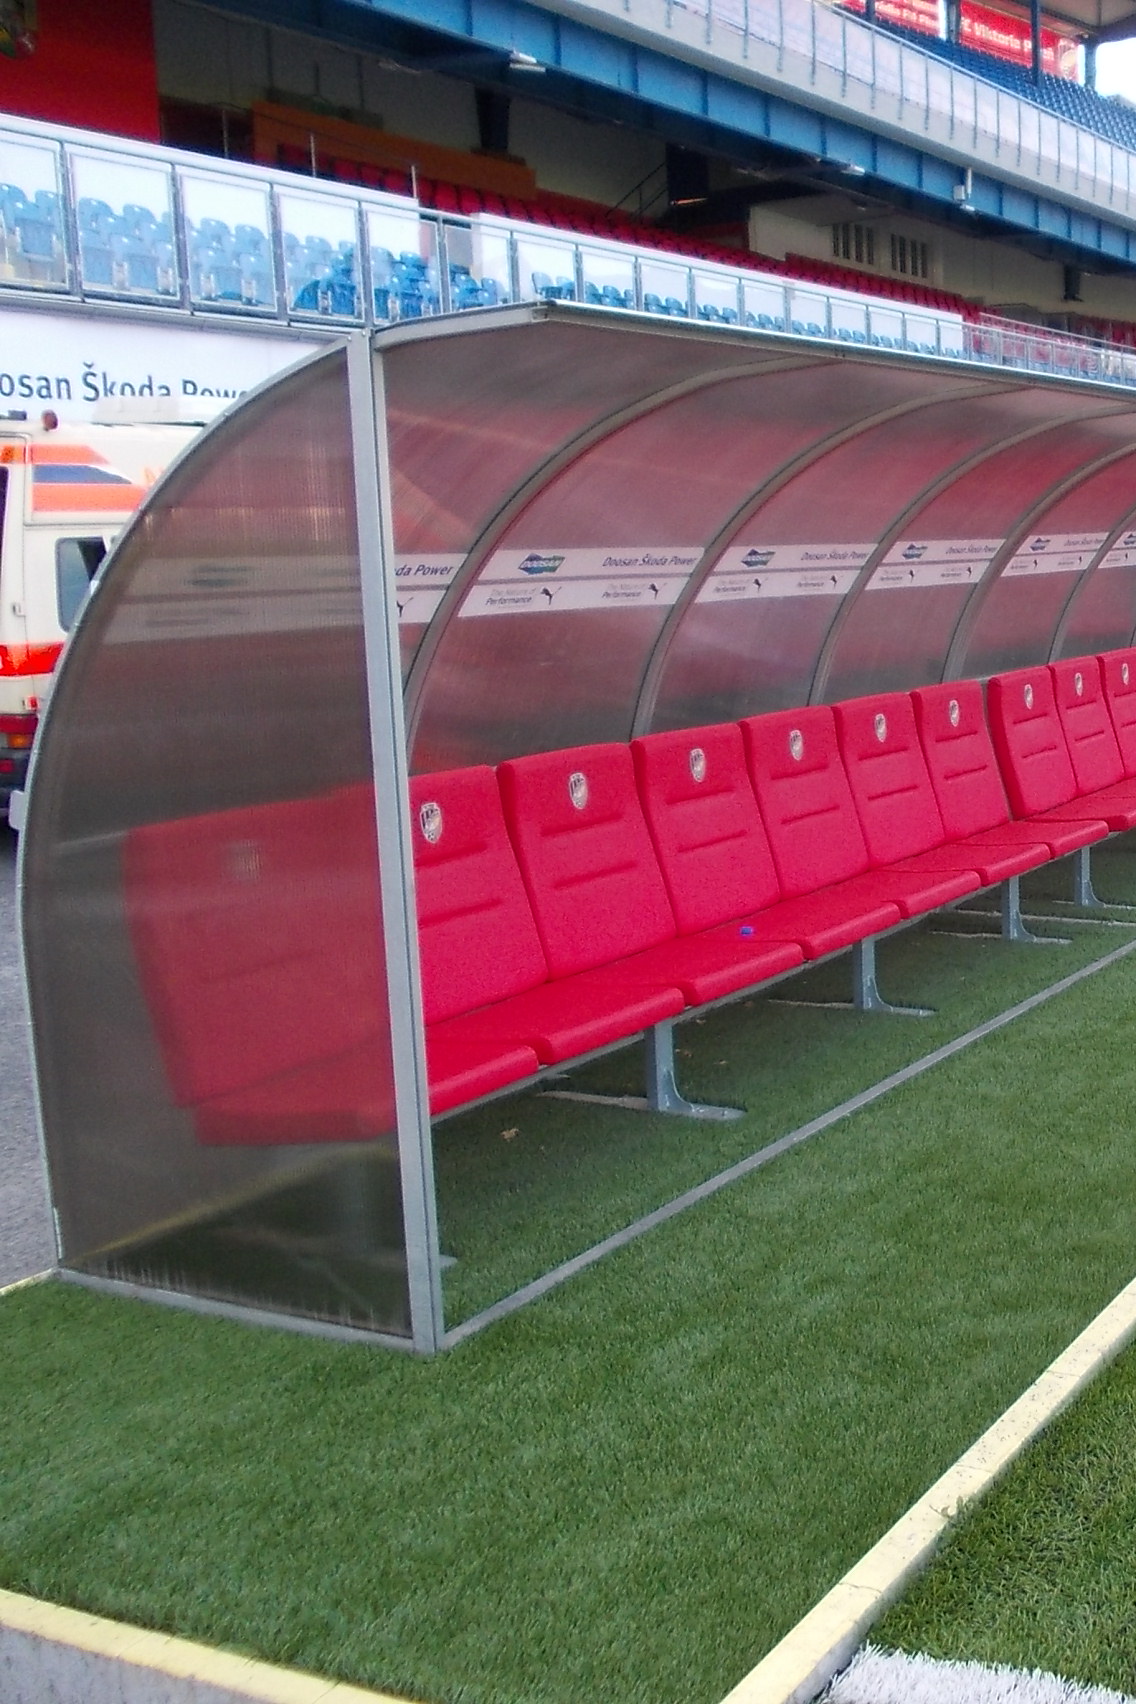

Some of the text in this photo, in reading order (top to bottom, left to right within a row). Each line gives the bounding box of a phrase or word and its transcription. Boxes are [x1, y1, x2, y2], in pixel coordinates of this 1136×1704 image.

[973, 22, 1021, 49] Viktoria
[602, 556, 638, 567] Doosan
[414, 564, 454, 576] Power
